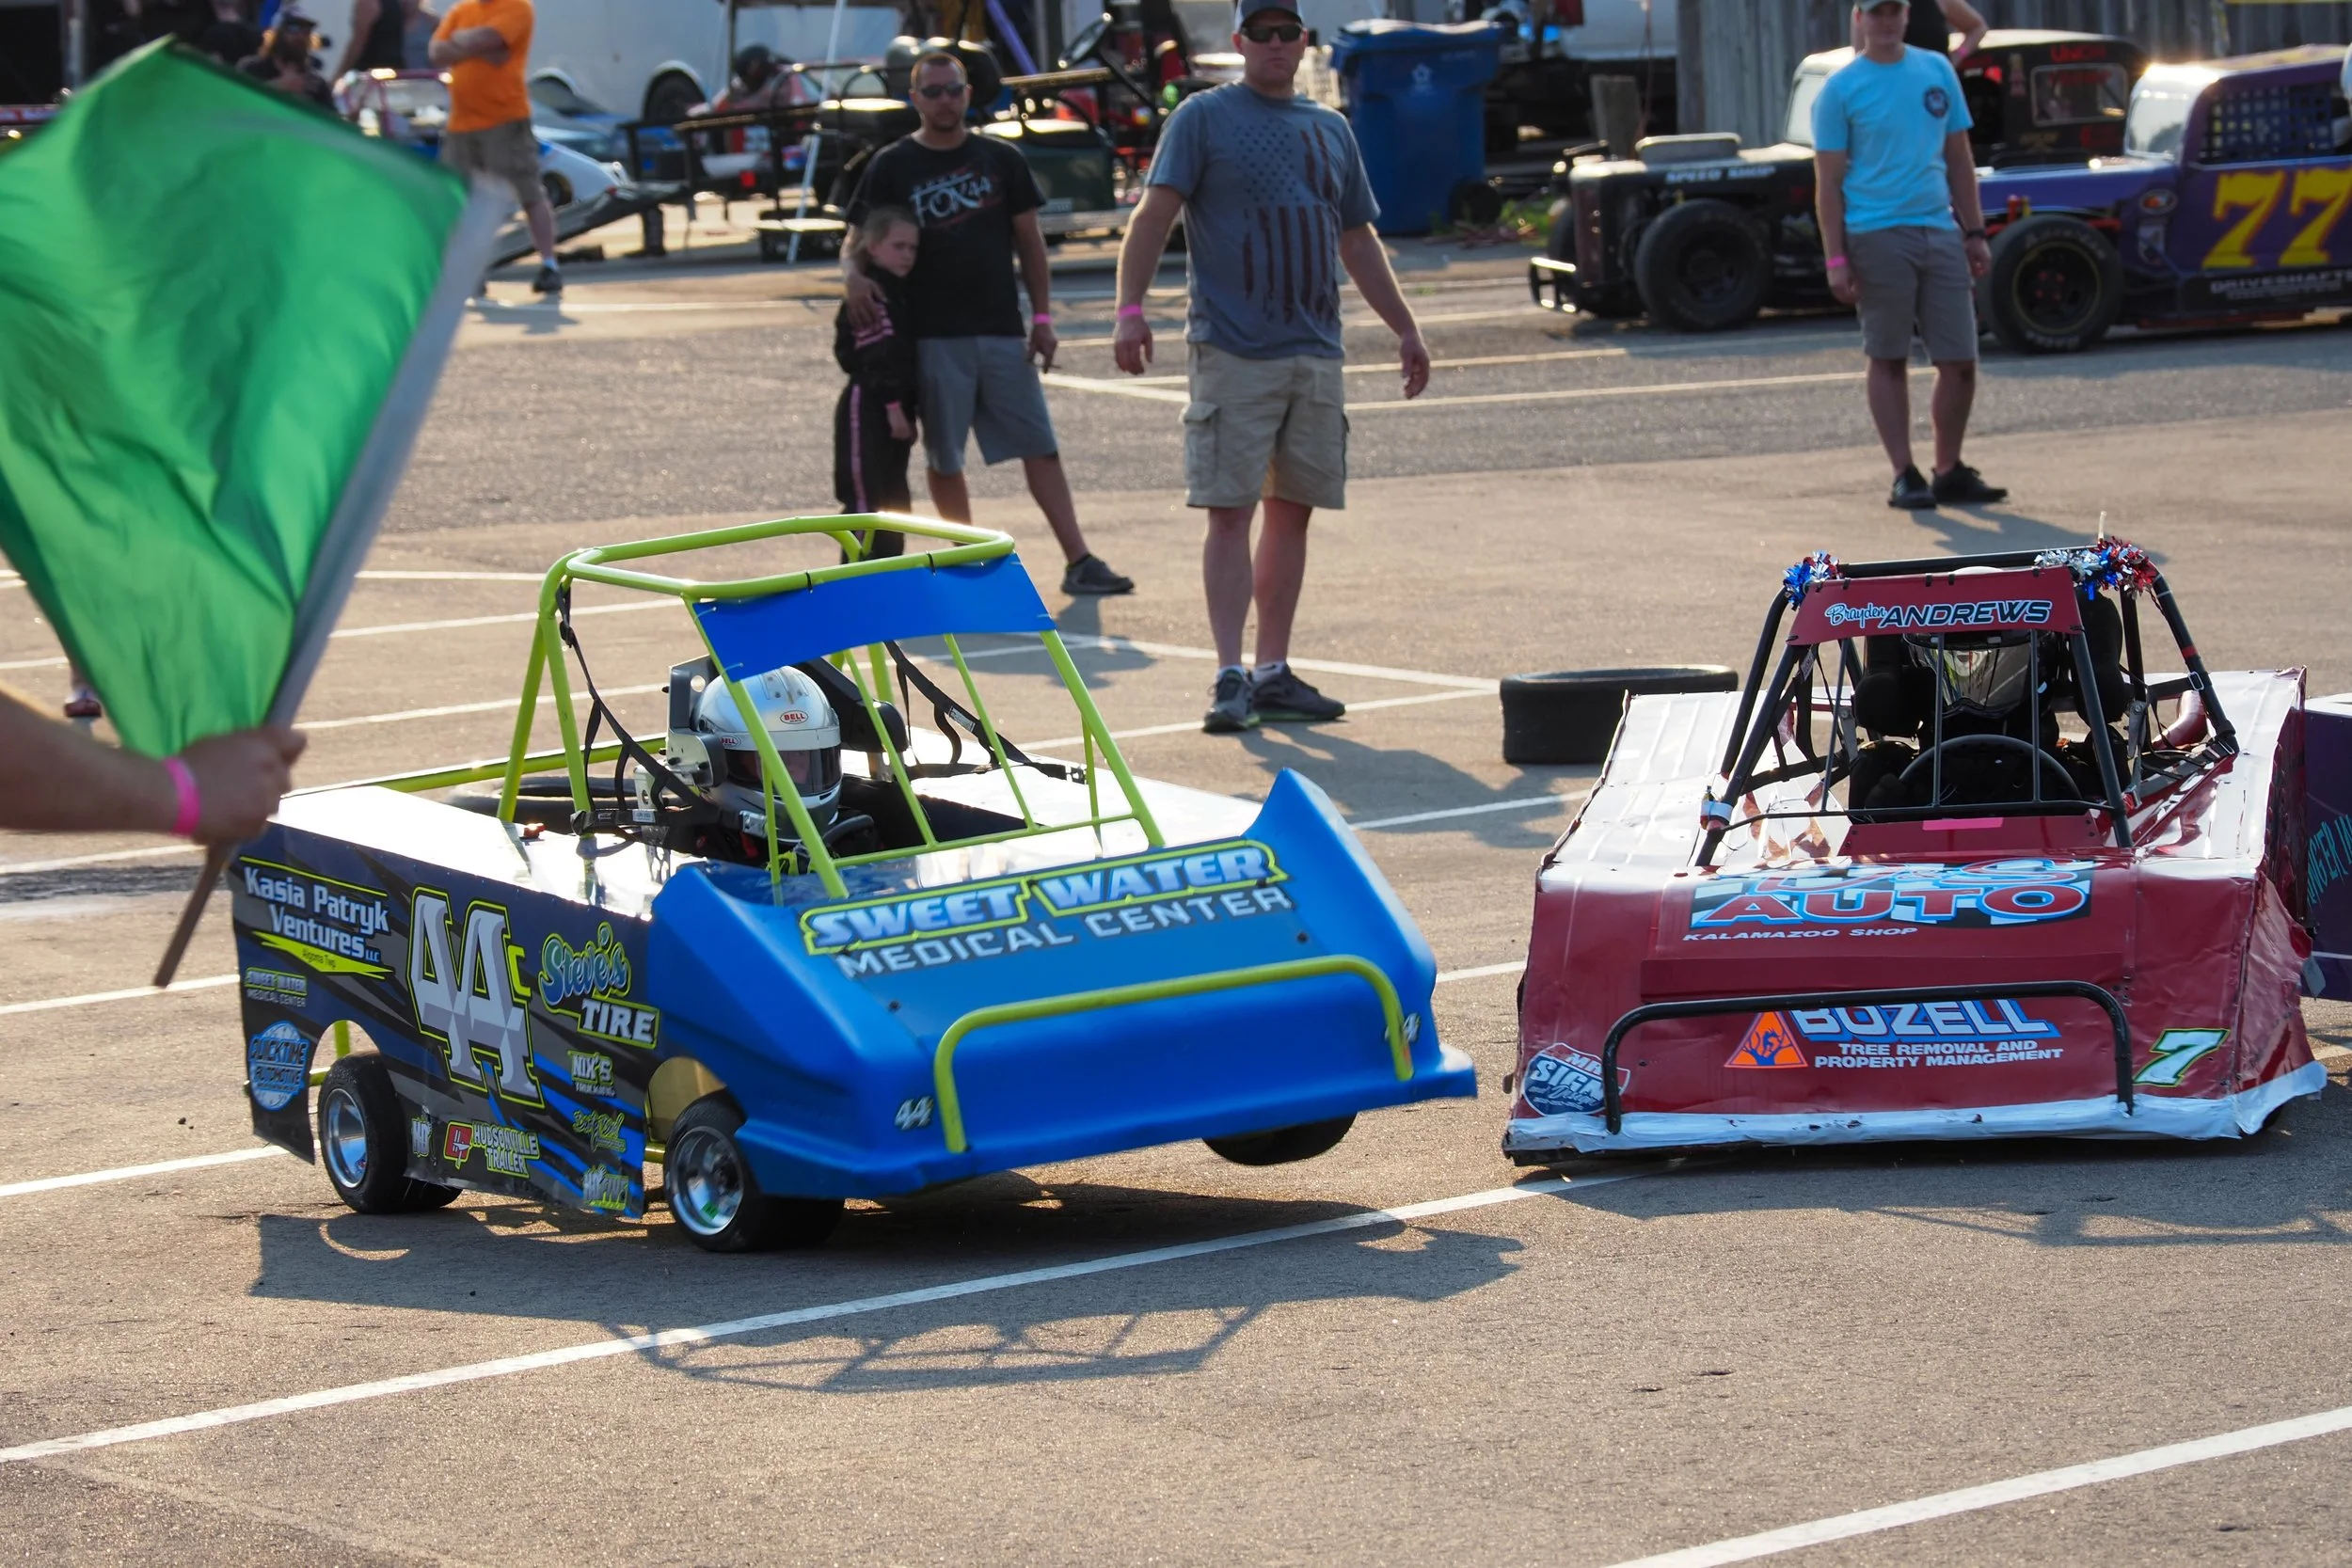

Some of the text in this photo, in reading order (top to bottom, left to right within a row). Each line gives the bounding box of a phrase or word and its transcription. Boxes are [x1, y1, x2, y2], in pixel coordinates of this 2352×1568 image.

[2201, 167, 2352, 270] 77
[1825, 600, 2053, 628] Brayden ANDREWS
[784, 713, 805, 721] BELL
[244, 865, 390, 936] Kasia Patryk
[810, 846, 1269, 947] SWEET WATER
[1692, 884, 2089, 926] AUTO
[268, 903, 381, 963] Ventures LLC
[835, 885, 1293, 978] MEDICAL CENTER
[1682, 927, 1919, 942] KALAMAZOO SHOP
[540, 927, 628, 1006] Steve's
[279, 992, 307, 1008] CENTER
[410, 894, 539, 1101] 44
[581, 997, 656, 1044] TIRE
[1790, 998, 2053, 1037] BOZELL
[249, 1037, 309, 1066] QUICKTIME
[1814, 1048, 2065, 1069] PROPERTY MANAGEMENT
[1837, 1039, 2039, 1056] TREE REMOVAL AND
[2133, 1027, 2230, 1087] 7
[255, 1066, 302, 1085] AUTOMOTIVE
[571, 1053, 612, 1083] NIX'S
[895, 1096, 933, 1130] 44
[473, 1124, 539, 1156] HUDSONVILLE
[486, 1148, 528, 1175] TRAILER
